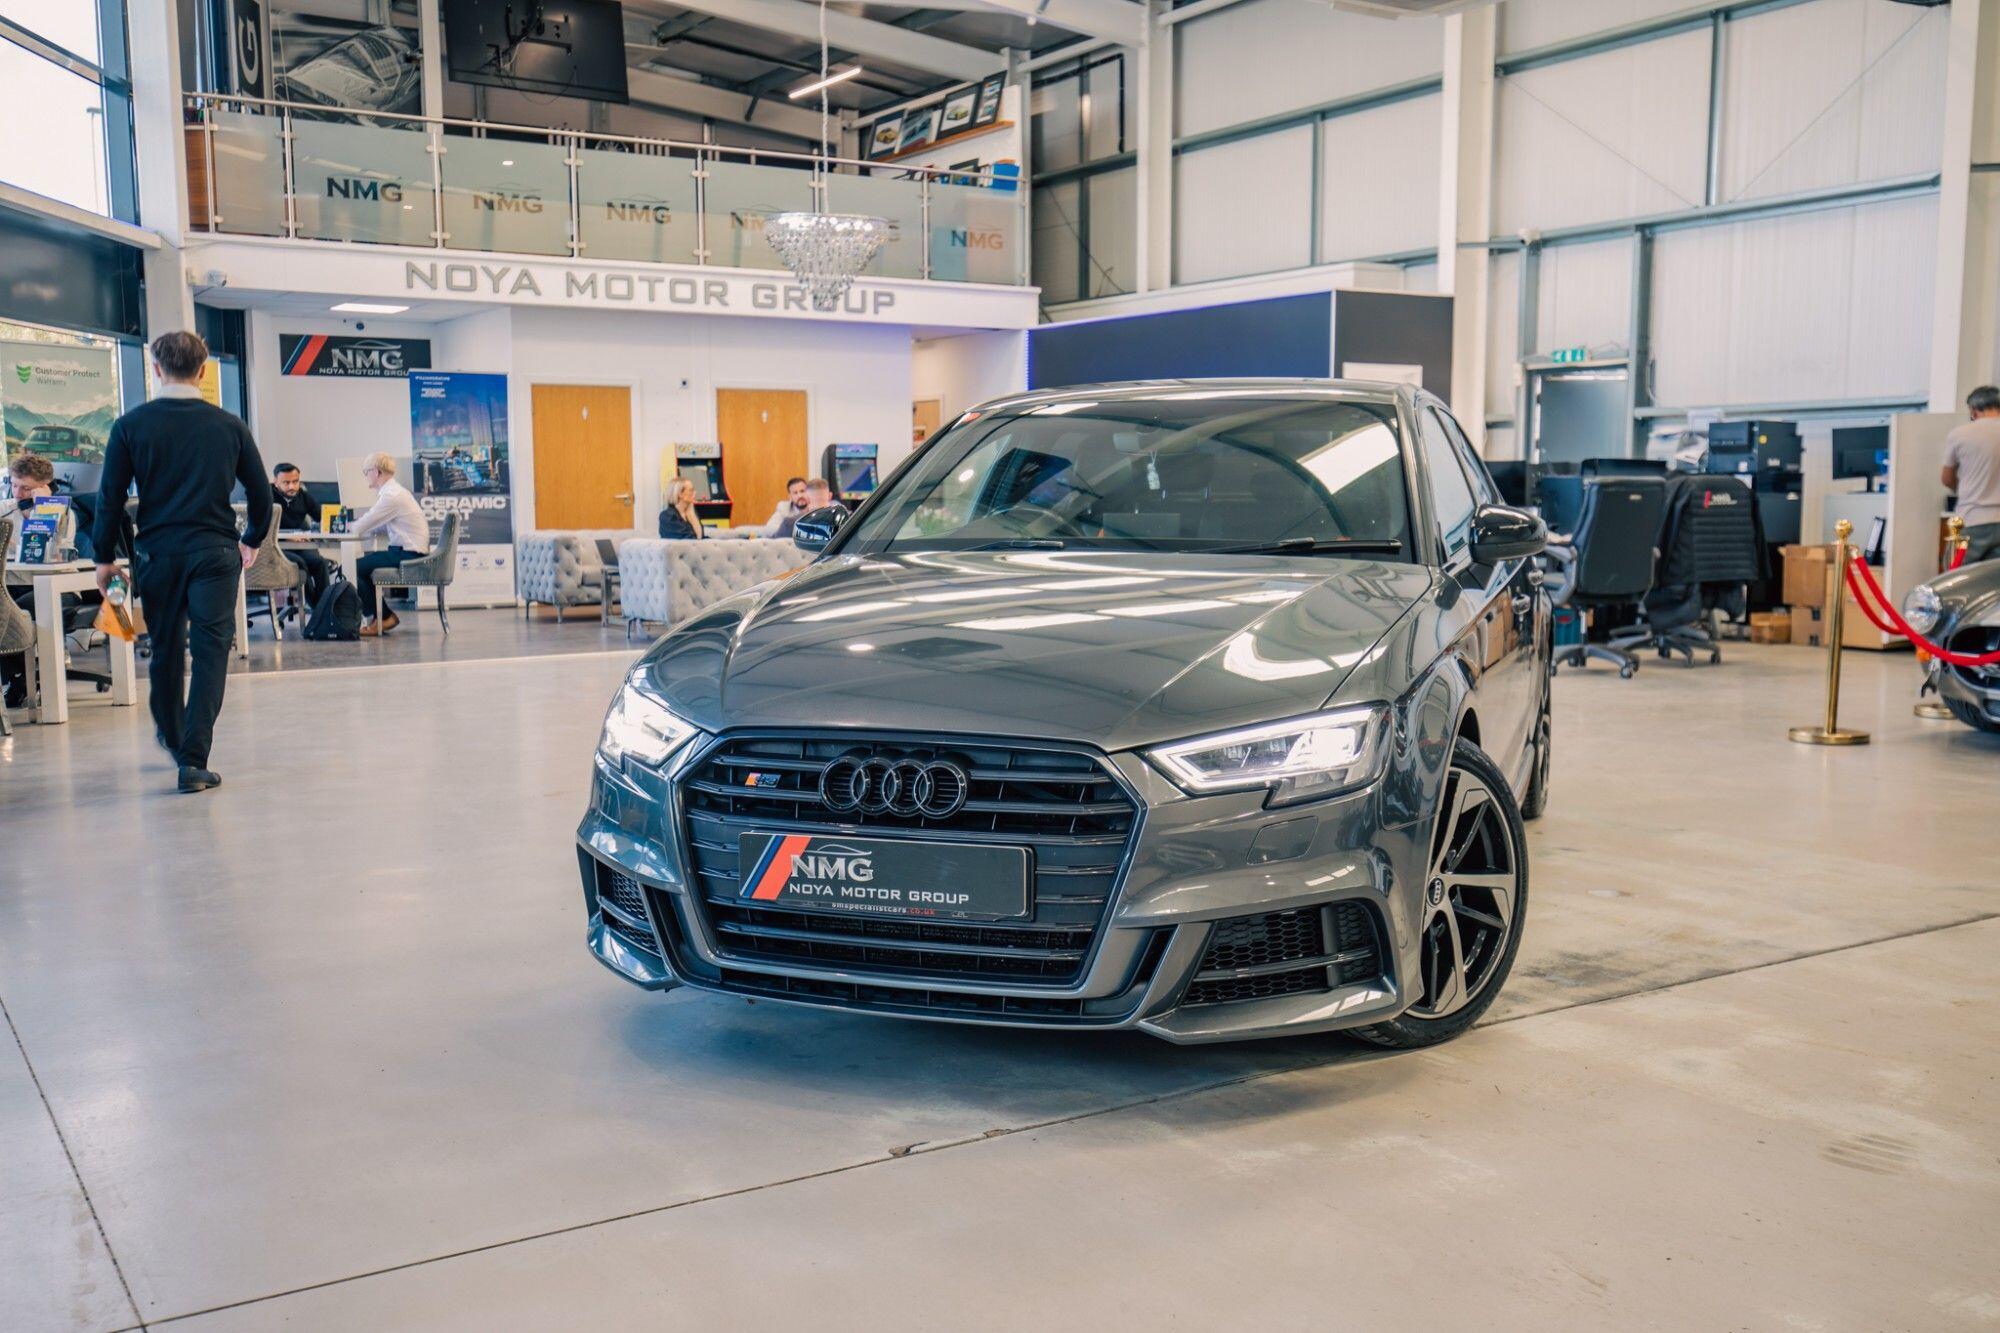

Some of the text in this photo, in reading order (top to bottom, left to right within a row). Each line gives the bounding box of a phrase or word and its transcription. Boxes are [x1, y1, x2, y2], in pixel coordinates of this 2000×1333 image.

[326, 176, 403, 202] NMG
[473, 192, 543, 214] NMG
[606, 202, 672, 224] NMG
[951, 230, 1004, 250] NMG
[406, 261, 542, 296] NOYA
[566, 271, 729, 307] MOTOR
[331, 348, 404, 370] NMG
[35, 367, 101, 378] Customer Protect
[319, 367, 345, 375] NOYA
[420, 496, 506, 510] CERAMIC
[790, 854, 874, 882] NMG
[789, 883, 970, 905] NOYA MOTOR GROUP
